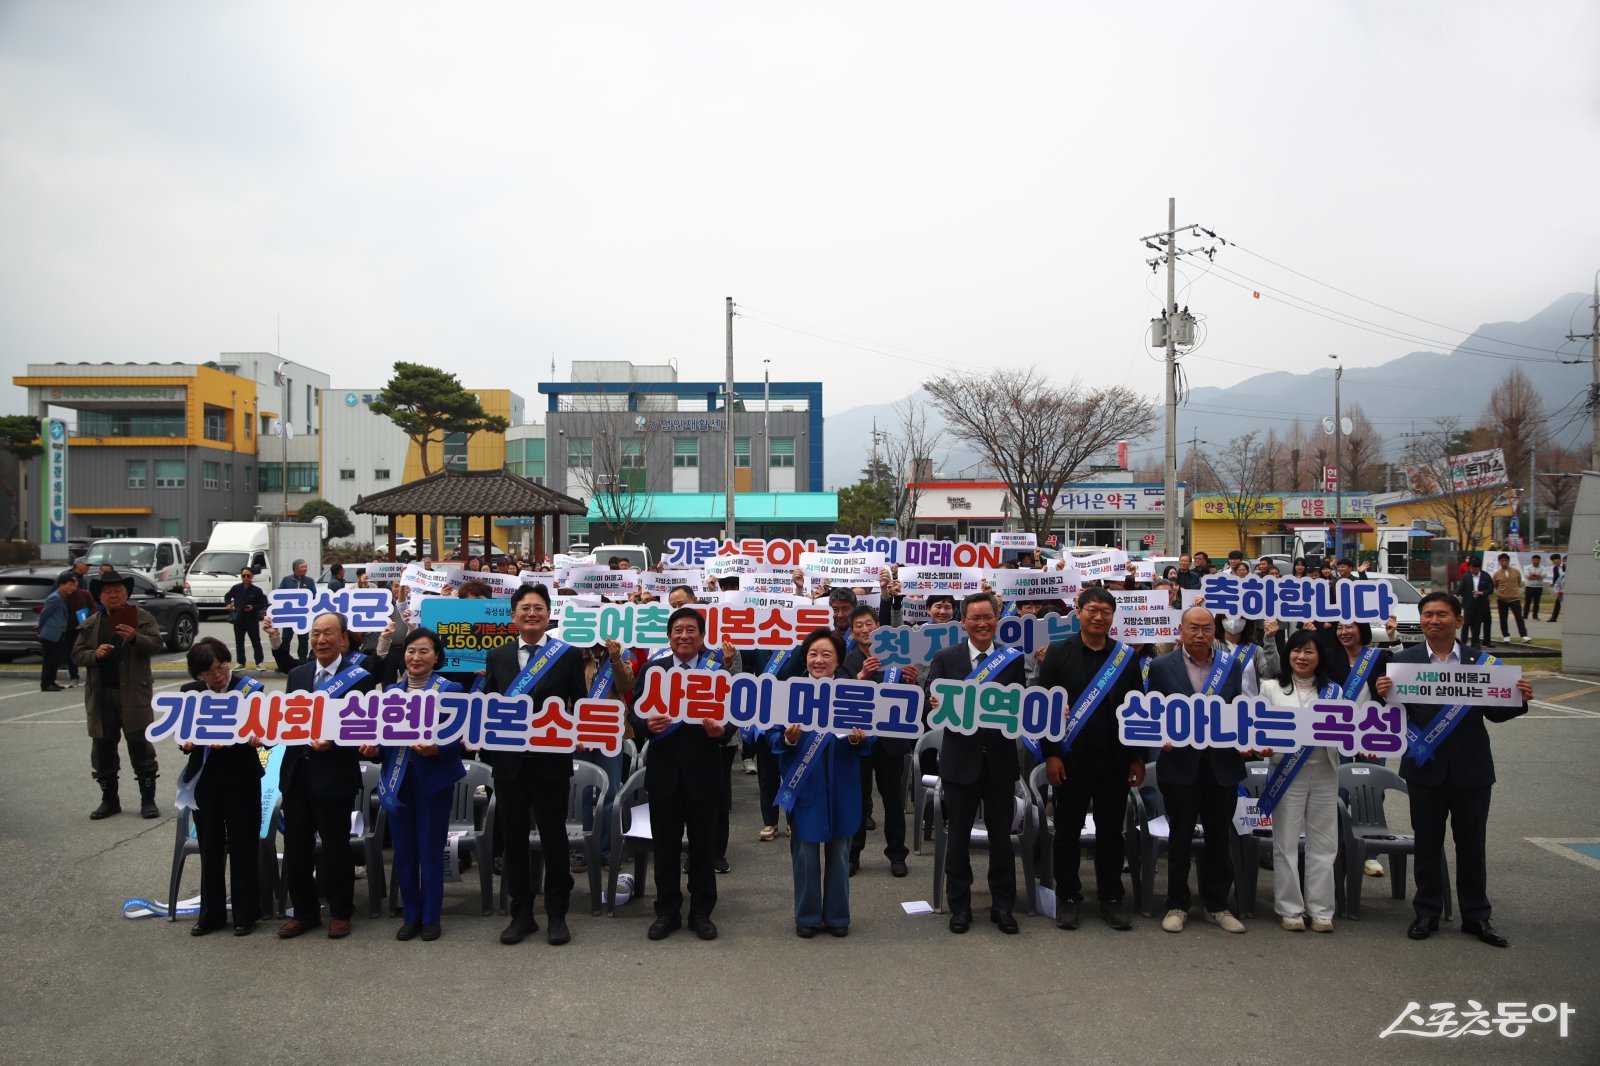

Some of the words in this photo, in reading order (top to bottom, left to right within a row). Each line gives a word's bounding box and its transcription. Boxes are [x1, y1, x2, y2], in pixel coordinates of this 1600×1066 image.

[1061, 493, 1138, 510] 다나은약국
[1205, 502, 1223, 513] 안흥
[1302, 498, 1325, 517] 안흥
[1144, 534, 1155, 545] 약
[819, 557, 842, 565] 사람이
[831, 566, 861, 574] 살아나는
[863, 566, 879, 574] 곡성
[903, 581, 962, 589] 기본소득·기본사회
[963, 581, 978, 589] 실현
[1015, 578, 1038, 586] 사람이
[1040, 576, 1063, 584] 머물고
[1002, 588, 1026, 596] 지역이
[1028, 586, 1059, 595] 살아나는
[1061, 585, 1077, 593] 곡성
[744, 597, 768, 606] 사람이
[1205, 577, 1394, 620] 축하합니다
[562, 606, 670, 645] 농어촌
[1123, 617, 1170, 625] 지방소멸대응!
[438, 623, 471, 635] 농어촌
[474, 623, 519, 635] 기본소득
[874, 629, 912, 665] 첫
[924, 618, 1034, 662] 지의
[1415, 671, 1451, 684] 사람이
[1455, 672, 1491, 684] 머물고
[1396, 685, 1431, 696] 지역이
[1435, 685, 1483, 698] 살아나는
[1487, 687, 1512, 699] 곡성
[639, 671, 776, 724] 사람이
[787, 682, 920, 734] 머물고
[932, 684, 1064, 737] 지역이
[151, 695, 325, 741] 기본사회
[339, 694, 436, 741] 실현!
[437, 697, 621, 752] 기본소득
[1121, 695, 1297, 747] 살아나는
[1312, 704, 1402, 752] 곡성
